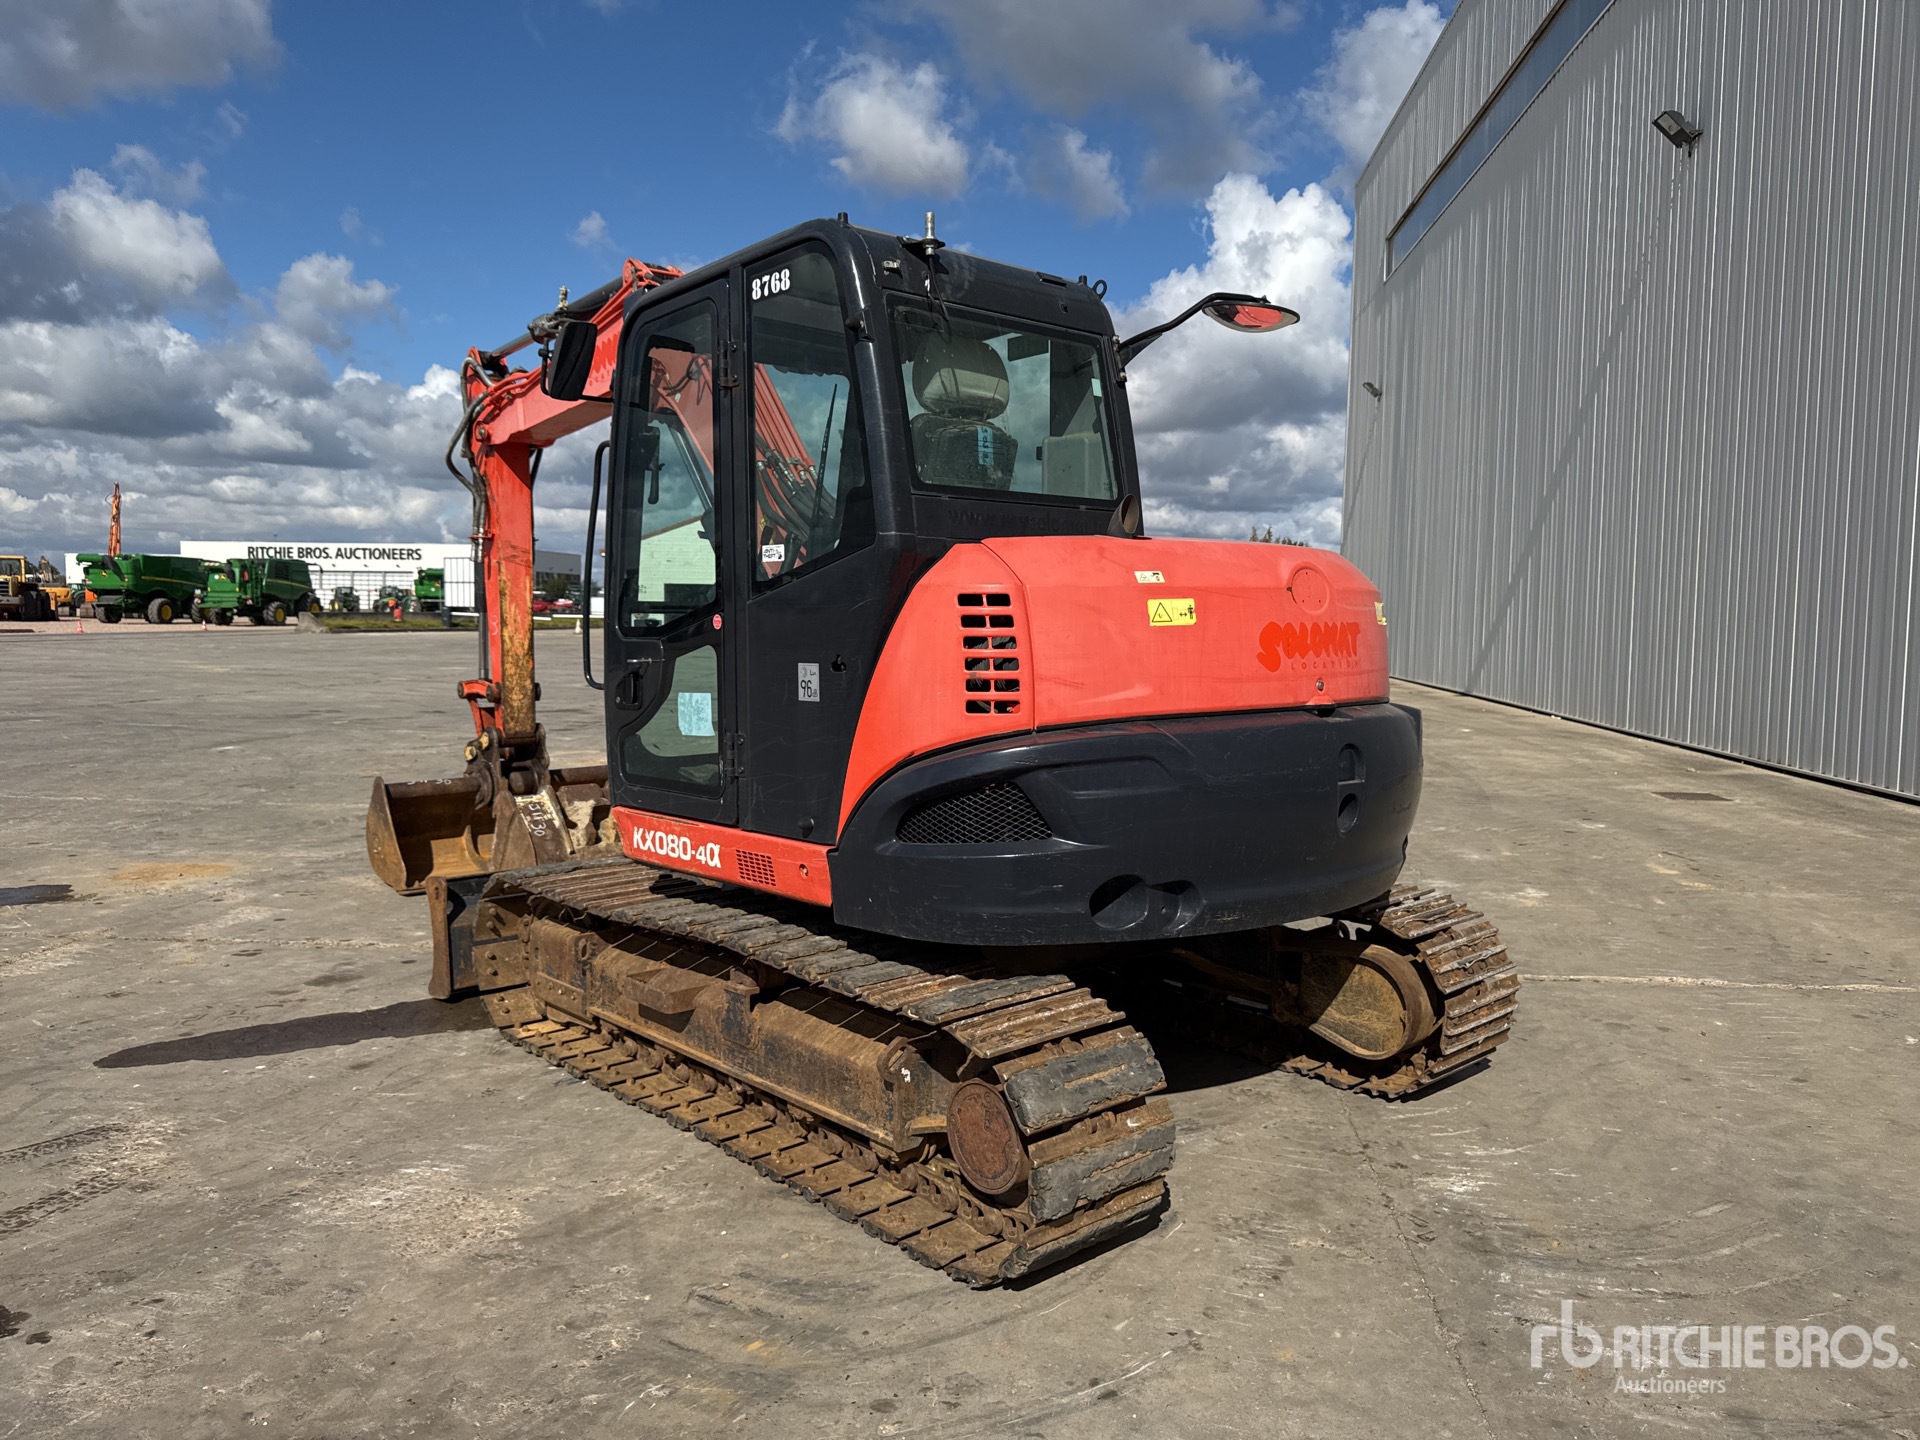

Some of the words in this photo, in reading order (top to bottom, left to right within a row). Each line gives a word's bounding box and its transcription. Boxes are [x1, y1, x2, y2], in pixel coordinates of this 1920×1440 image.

[752, 268, 791, 300] 8768
[247, 546, 294, 559] RITCHIE
[297, 547, 333, 560] BROS.
[335, 547, 422, 561] AUCTIONEERS
[1256, 621, 1361, 673] SOLOMAT
[1291, 660, 1361, 671] LOCATION
[800, 679, 813, 698] 96
